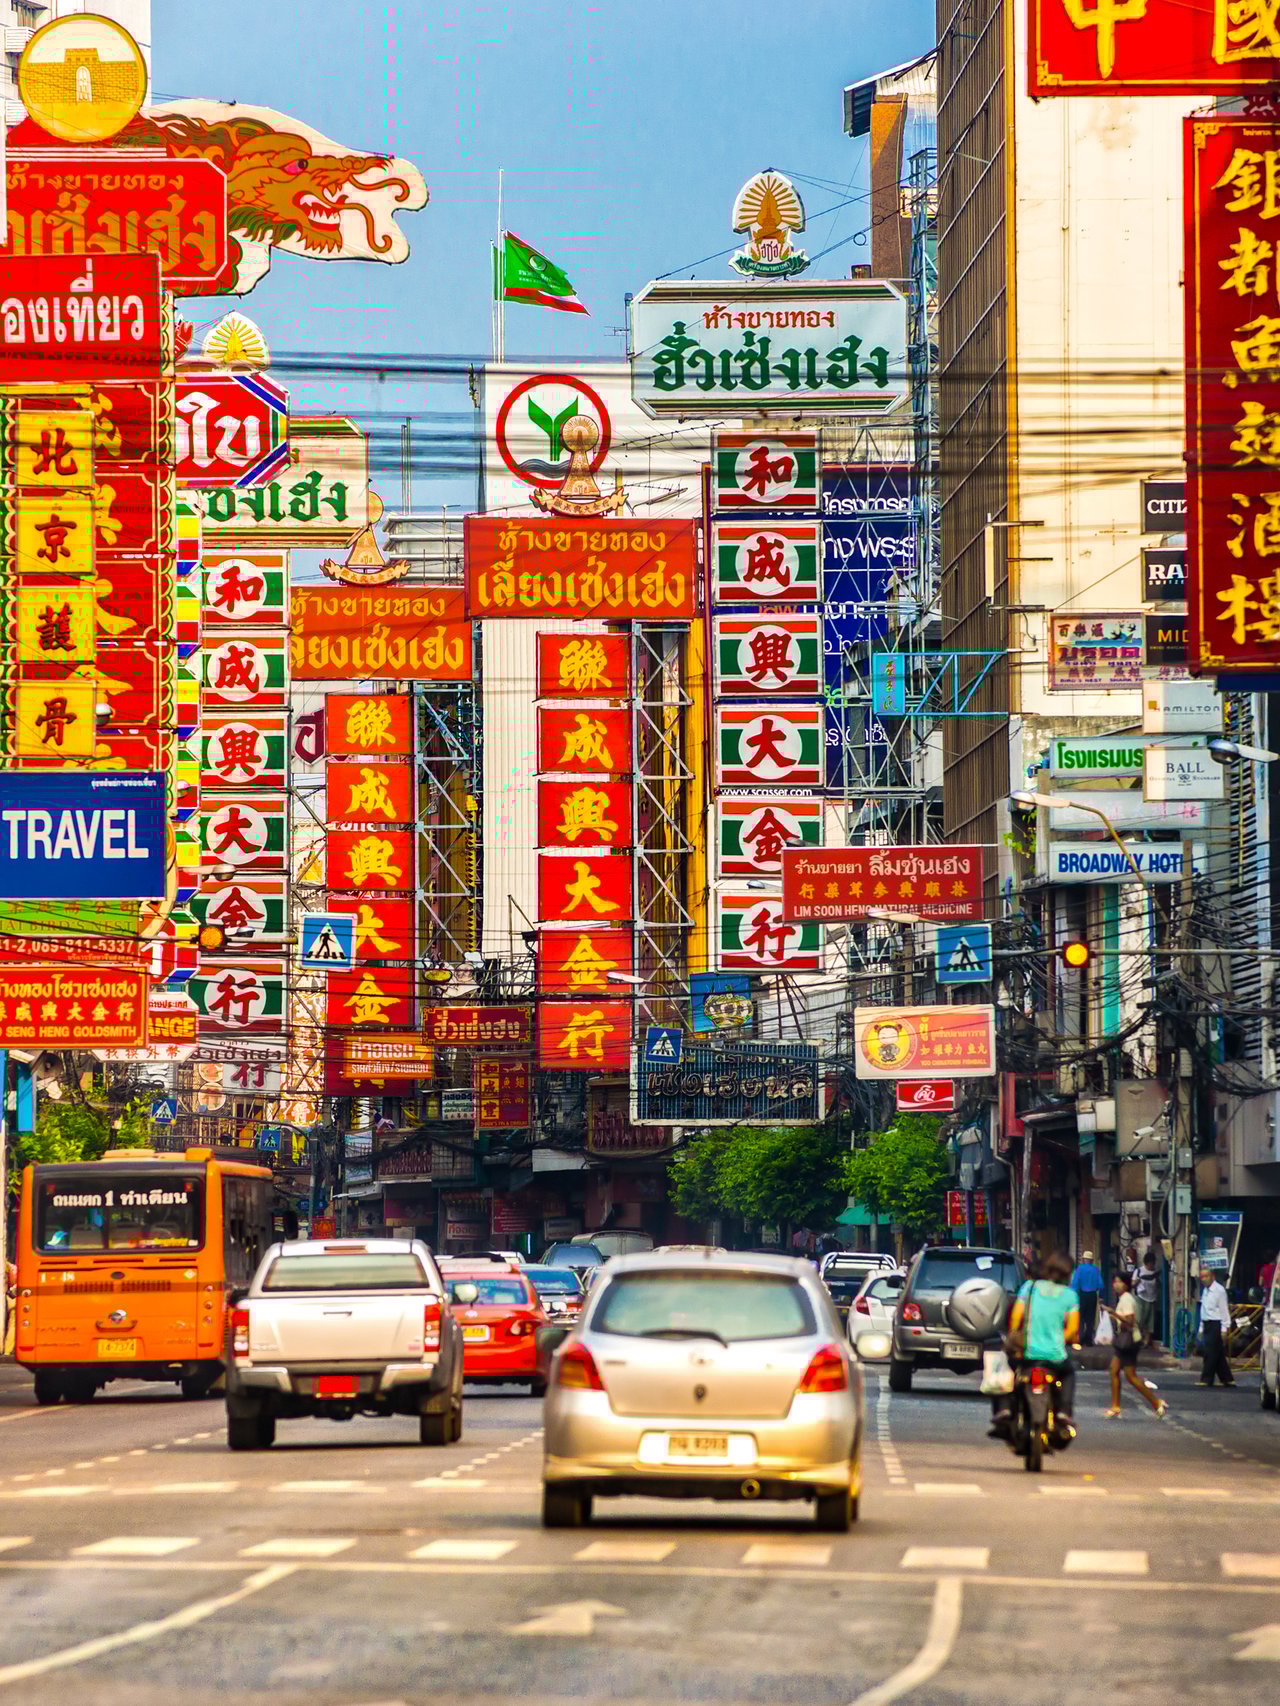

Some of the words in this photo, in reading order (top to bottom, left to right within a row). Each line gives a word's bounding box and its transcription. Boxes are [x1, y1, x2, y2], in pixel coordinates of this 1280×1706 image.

[703, 305, 835, 328] ห้างขายทอง
[499, 521, 665, 552] ห้างขายทอง
[1148, 564, 1188, 579] RA
[1165, 762, 1205, 774] BALL
[2, 809, 149, 860] TRAVEL
[794, 858, 862, 874] ร้านขายยา
[1058, 852, 1143, 873] BROADWAY
[1149, 852, 1199, 873] HOTL
[793, 905, 813, 918] LIM
[814, 905, 842, 917] SOON
[844, 905, 871, 917] HENG
[922, 903, 973, 915] MEDICINE
[6, 1025, 36, 1037] SENG
[39, 1025, 70, 1037] HENG
[73, 1025, 137, 1037] GOLDSMITH
[53, 1195, 102, 1207] ถนนตก
[105, 1190, 114, 1206] 1
[120, 1189, 188, 1205] ท่าเตียน
